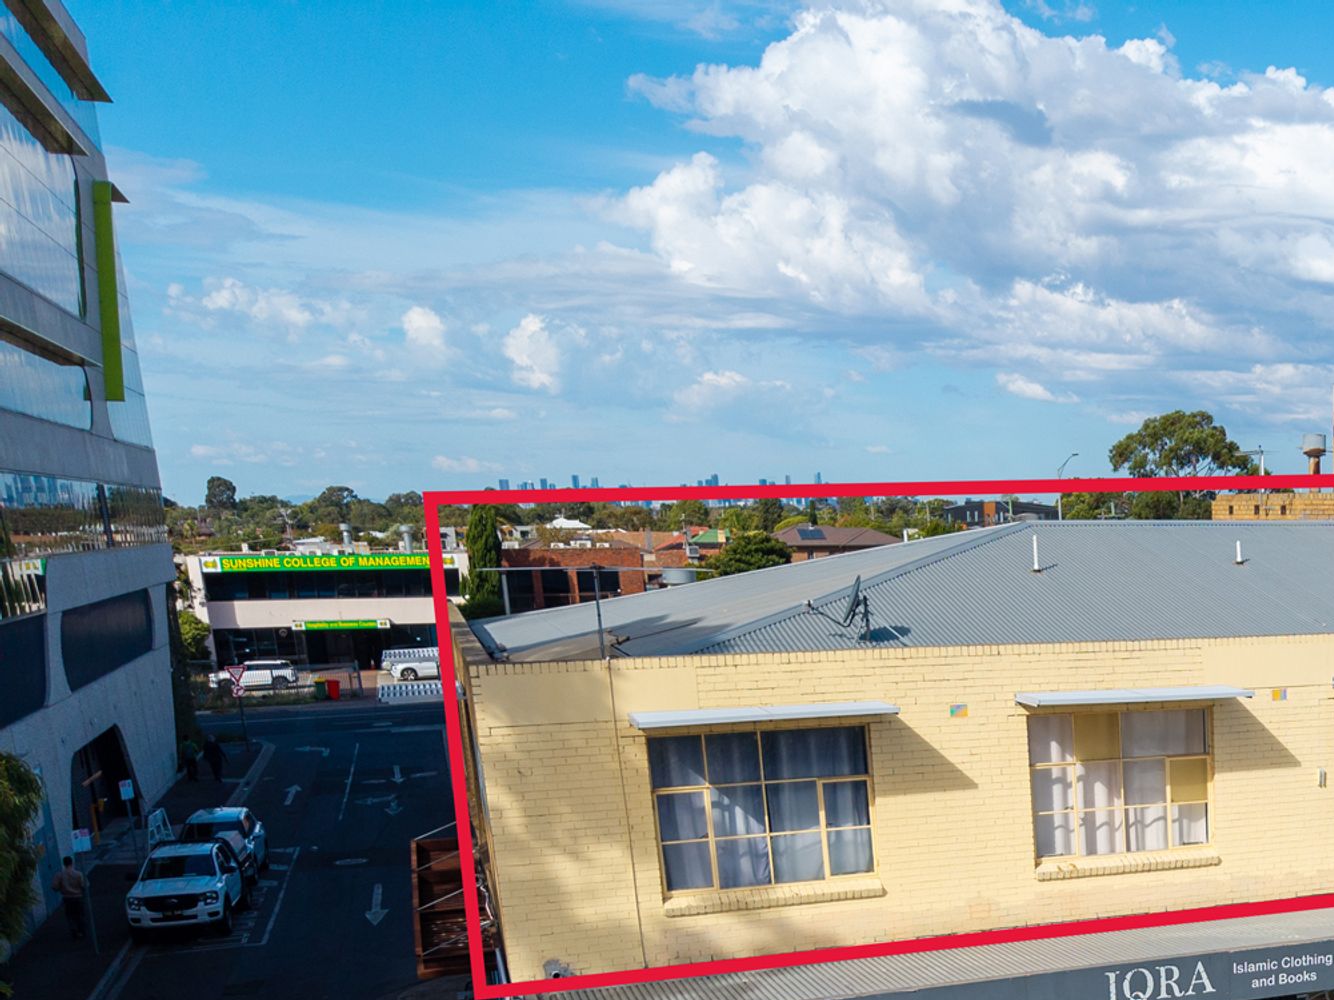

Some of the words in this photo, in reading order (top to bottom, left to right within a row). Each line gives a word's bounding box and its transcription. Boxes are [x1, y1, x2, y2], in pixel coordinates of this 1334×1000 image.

[222, 558, 280, 570] SUNSHINE
[283, 557, 337, 568] COLLEGE
[340, 557, 355, 567] OF
[358, 555, 429, 567] MANAGEMEN
[1233, 960, 1279, 975] Islamic
[1281, 952, 1334, 970] Clothing
[1251, 976, 1276, 989] and
[1278, 970, 1317, 986] Books
